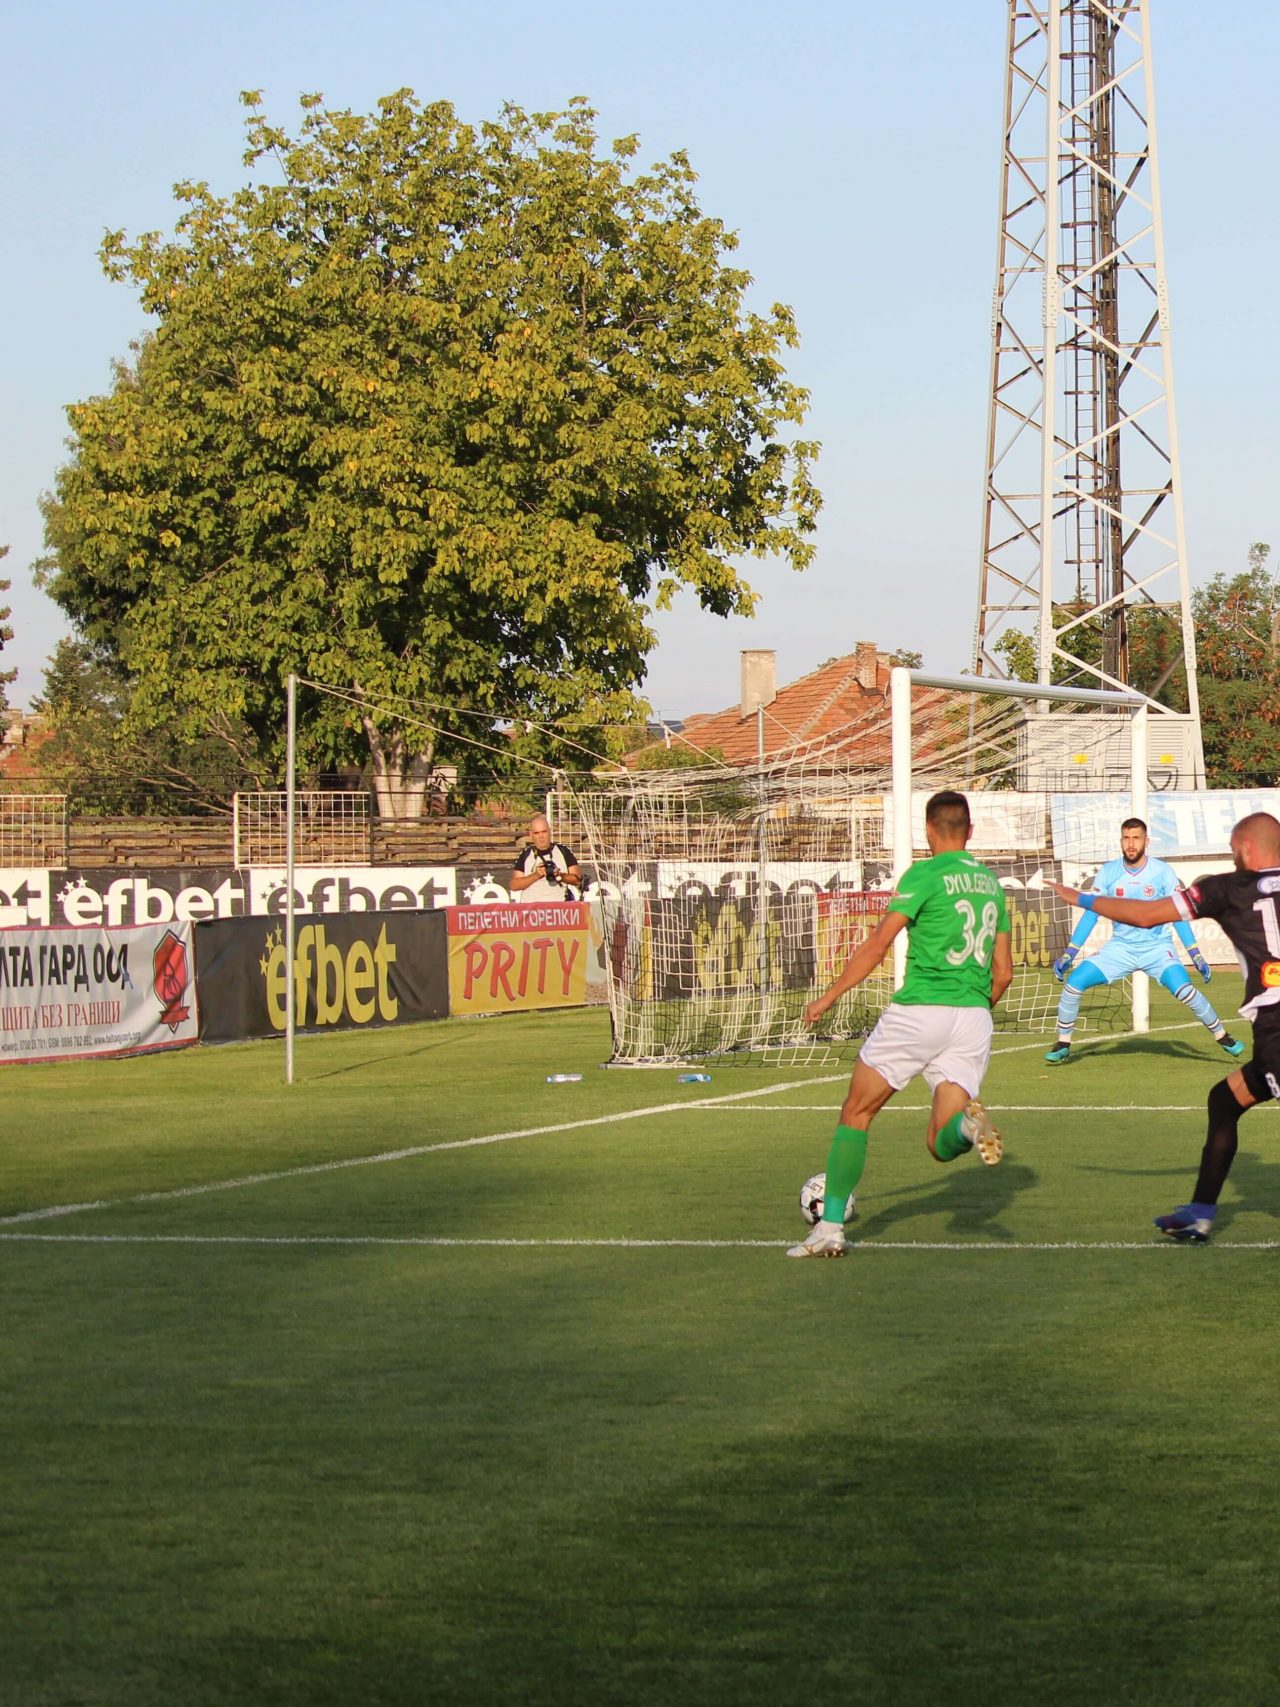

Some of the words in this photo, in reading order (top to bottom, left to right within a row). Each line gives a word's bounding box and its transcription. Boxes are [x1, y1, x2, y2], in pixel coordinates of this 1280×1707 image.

[63, 877, 244, 927] efbet
[266, 876, 448, 916] efbet
[458, 910, 519, 931] ПЕЛЕТНИ
[522, 909, 580, 928] ГОРЕЛКИ
[945, 899, 998, 967] 38
[39, 943, 90, 992] ГАРД
[266, 922, 398, 1031] efbet
[463, 937, 580, 1002] PRITY
[0, 1006, 39, 1033] ЩИТА
[41, 1003, 63, 1028] БЕЗ
[66, 1001, 121, 1028] ГРАНИЦИ
